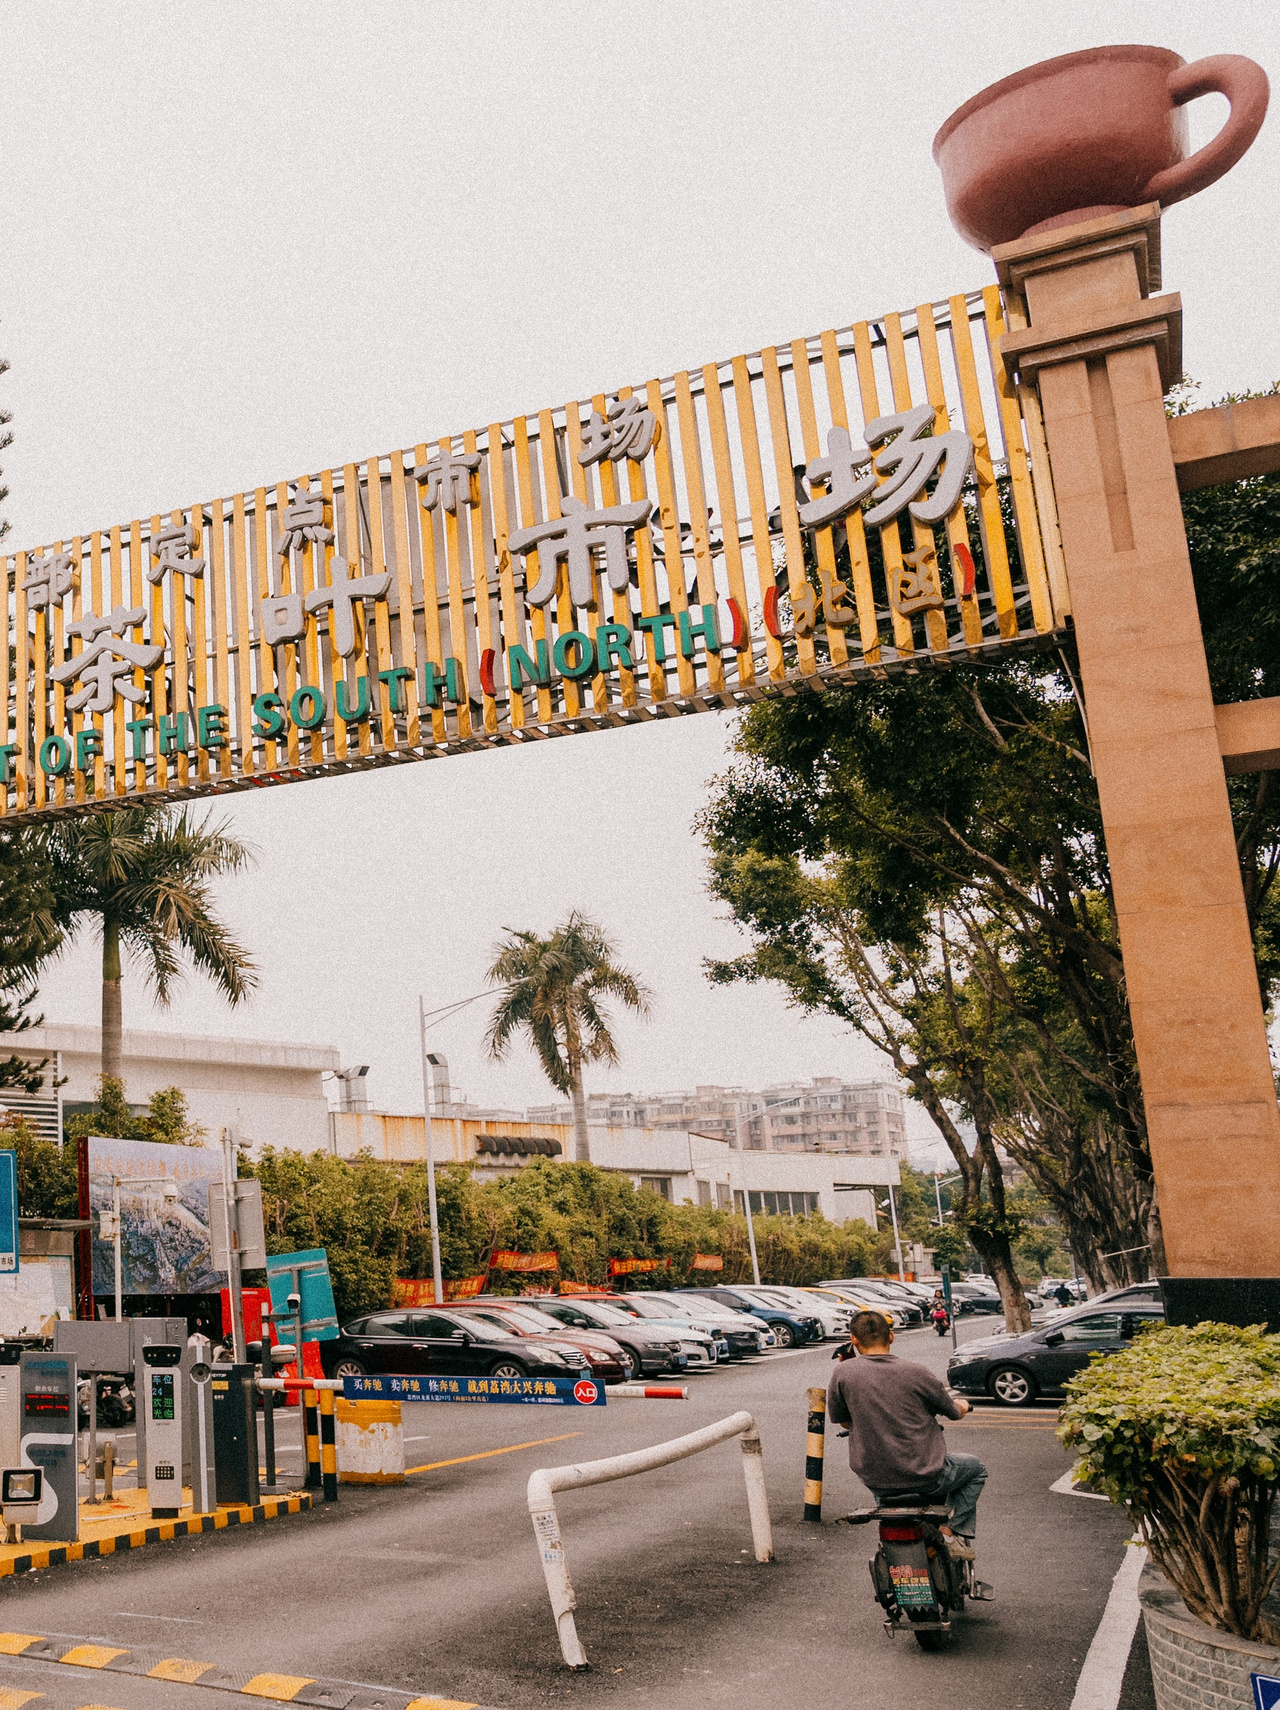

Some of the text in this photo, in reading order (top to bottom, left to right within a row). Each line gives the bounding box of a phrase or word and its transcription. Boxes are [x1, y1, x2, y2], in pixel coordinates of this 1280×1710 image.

[39, 728, 103, 776] OF
[125, 703, 228, 762] THE
[253, 657, 461, 738] SOUTH
[152, 1375, 173, 1385] 车位
[577, 1387, 596, 1398] 入口
[152, 1397, 173, 1408] 欢迎
[153, 1409, 174, 1419] 光临
